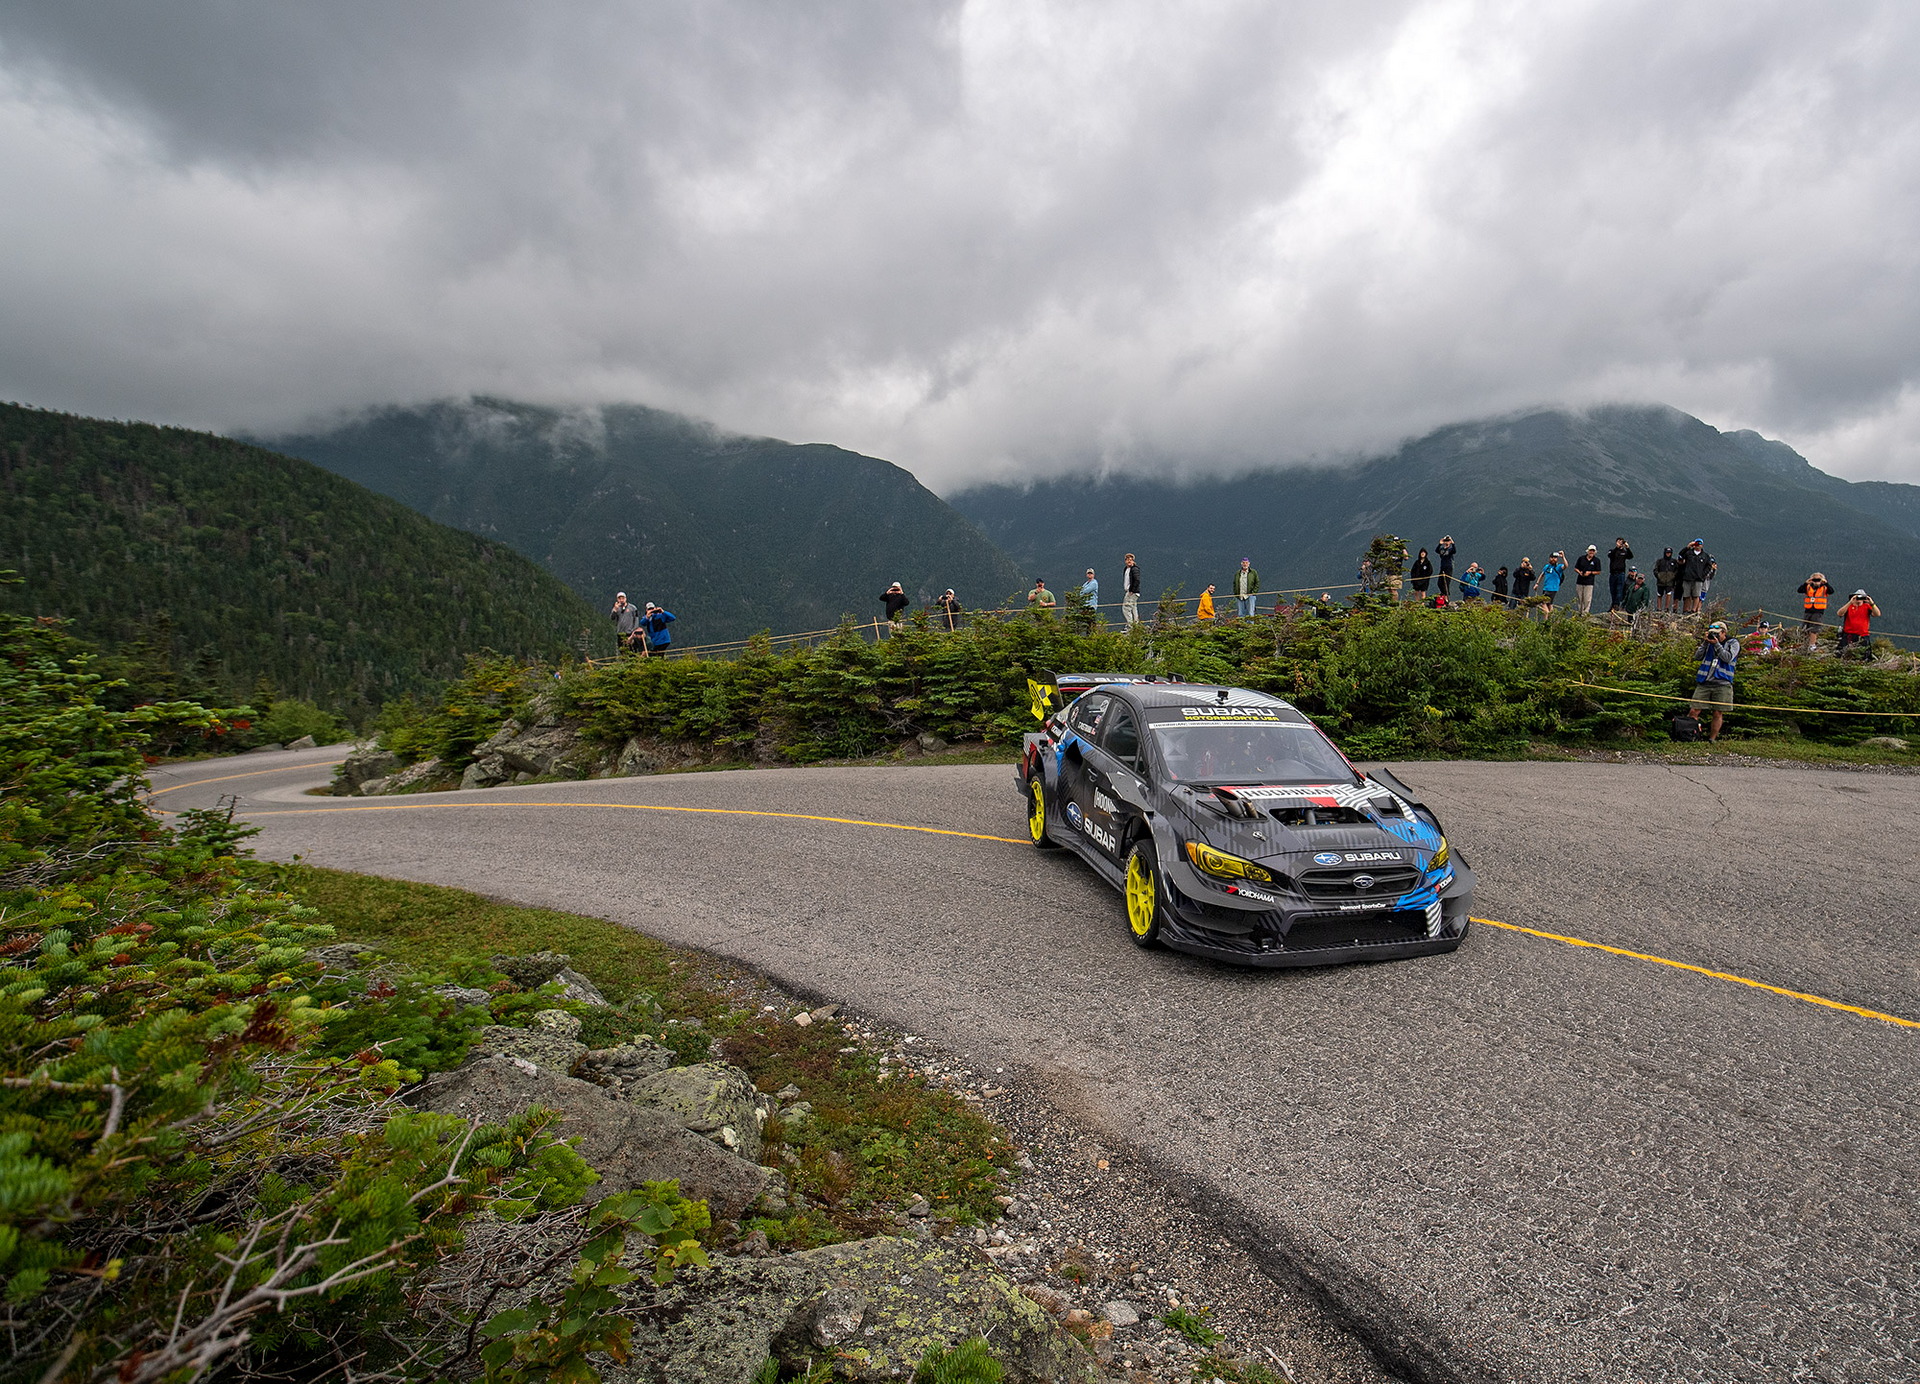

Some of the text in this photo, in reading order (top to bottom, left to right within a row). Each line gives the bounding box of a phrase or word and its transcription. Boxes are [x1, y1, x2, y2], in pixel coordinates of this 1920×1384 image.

[1181, 707, 1275, 716] SUBARU
[1083, 817, 1116, 853] SUBAR
[1344, 851, 1403, 862] SUBARU
[1238, 888, 1275, 903] YOKOHAMA
